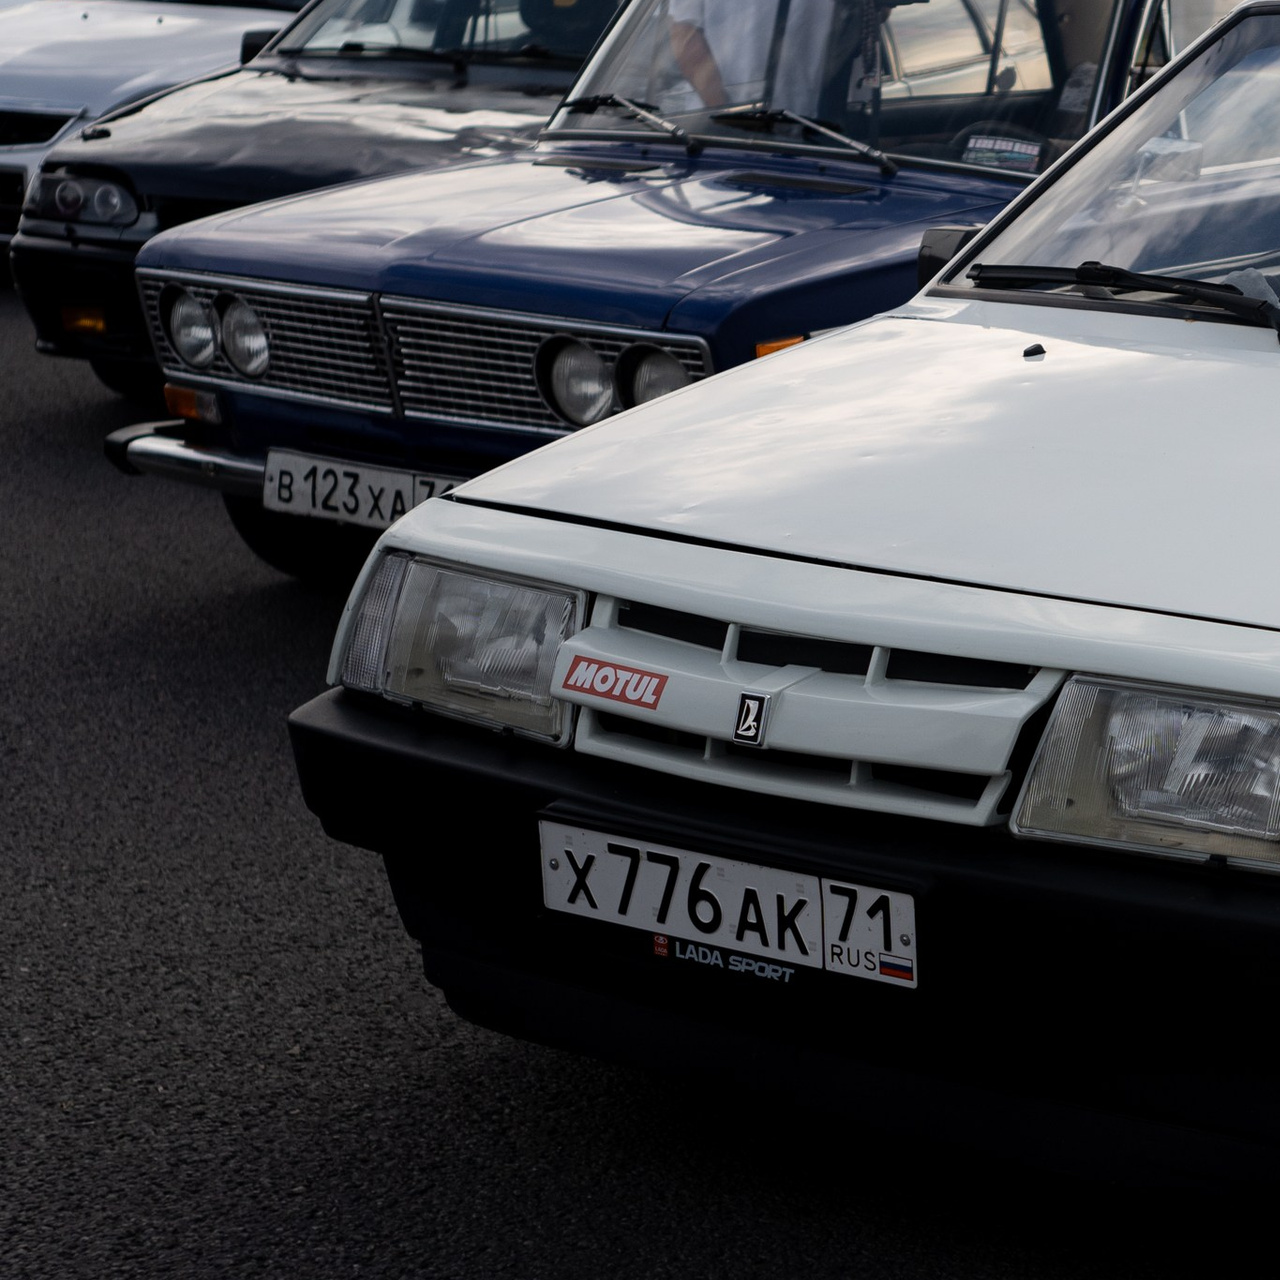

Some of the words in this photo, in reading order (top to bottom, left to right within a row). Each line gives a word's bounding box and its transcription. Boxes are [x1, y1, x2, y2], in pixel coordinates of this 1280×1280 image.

[567, 661, 660, 704] MOTUL
[829, 884, 892, 952] 71
[675, 941, 724, 968] LADA
[728, 956, 795, 983] SPORT
[830, 943, 876, 972] RUS
